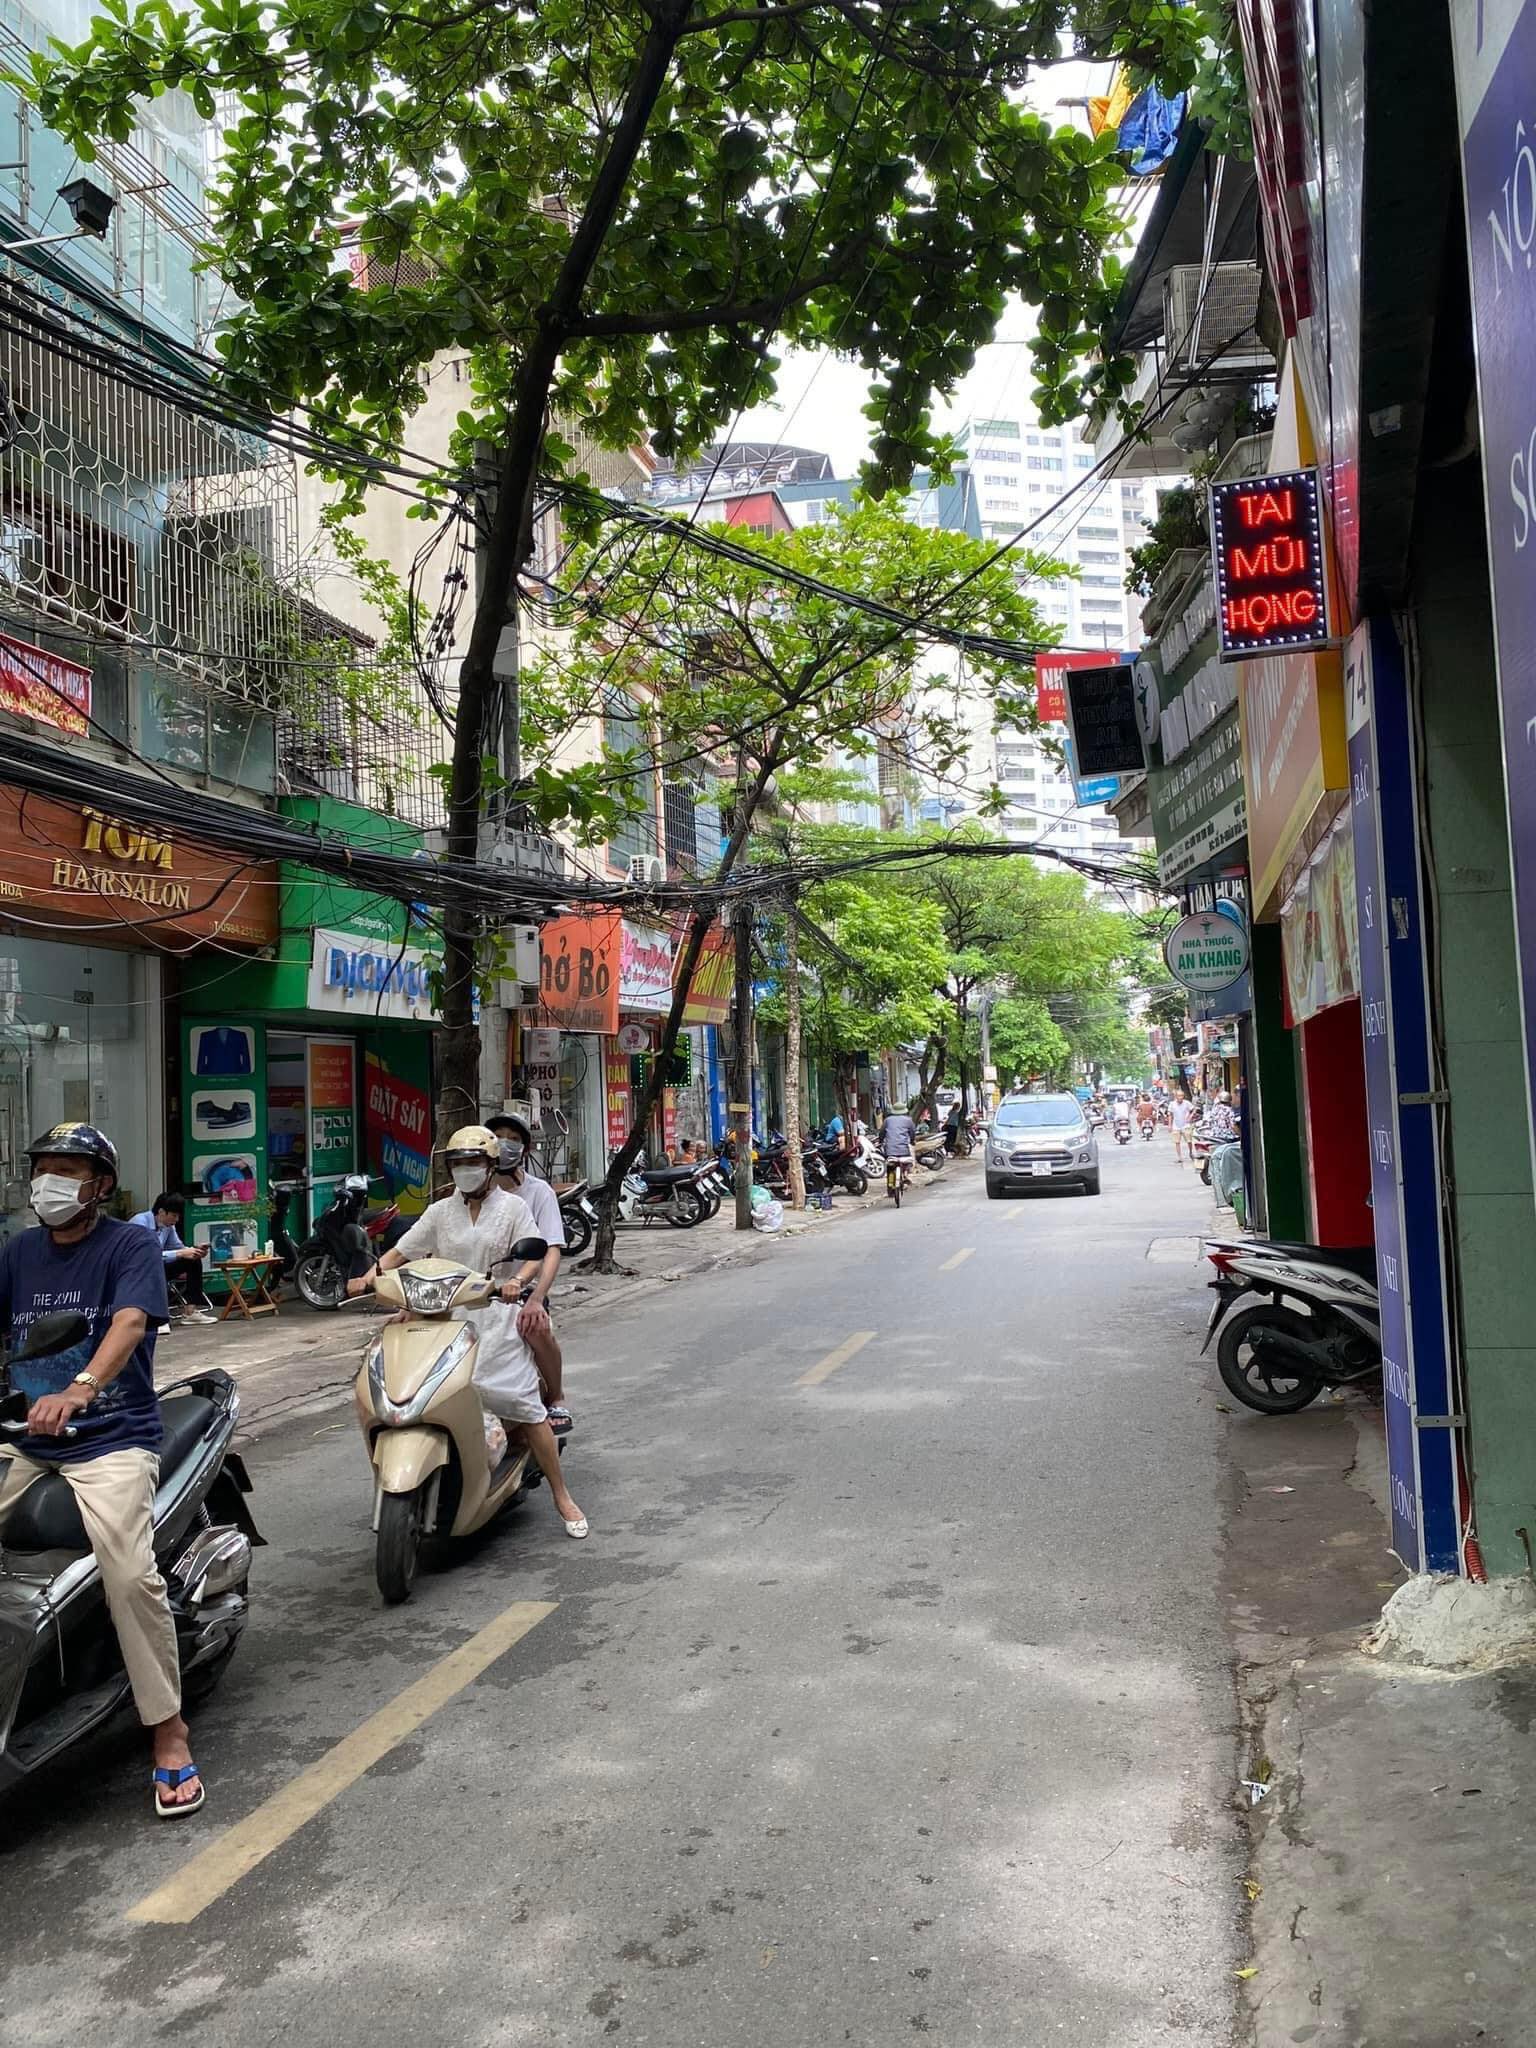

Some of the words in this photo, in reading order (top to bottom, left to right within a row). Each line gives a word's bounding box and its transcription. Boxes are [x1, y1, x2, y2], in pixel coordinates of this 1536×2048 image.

[1487, 118, 1536, 304] NỘ
[1240, 490, 1293, 525] TAI
[1234, 535, 1305, 578] MŨI
[1229, 589, 1316, 633] HỌNG
[1346, 650, 1367, 720] 74
[1354, 759, 1370, 806] BÁC
[79, 805, 174, 870] TOM
[52, 857, 115, 896] HAIR
[119, 871, 191, 911] SALON
[1178, 953, 1195, 970] AN
[1199, 949, 1241, 968] KHANG
[1182, 937, 1201, 949] NHÀ
[1204, 935, 1234, 947] THUỐC
[326, 947, 391, 998] DỊCH
[540, 935, 571, 993] hở
[580, 947, 609, 998] Bò
[1364, 997, 1387, 1043] BỆNH
[400, 1098, 426, 1135] SẤY
[402, 1155, 428, 1185] NGAY
[1373, 1124, 1393, 1171] VIỆN
[1383, 1254, 1399, 1292] NHI
[33, 1293, 52, 1306] THE
[54, 1290, 81, 1305] XVIII
[1383, 1355, 1412, 1407] TRUNG
[1391, 1473, 1417, 1530] ƯƠNG
